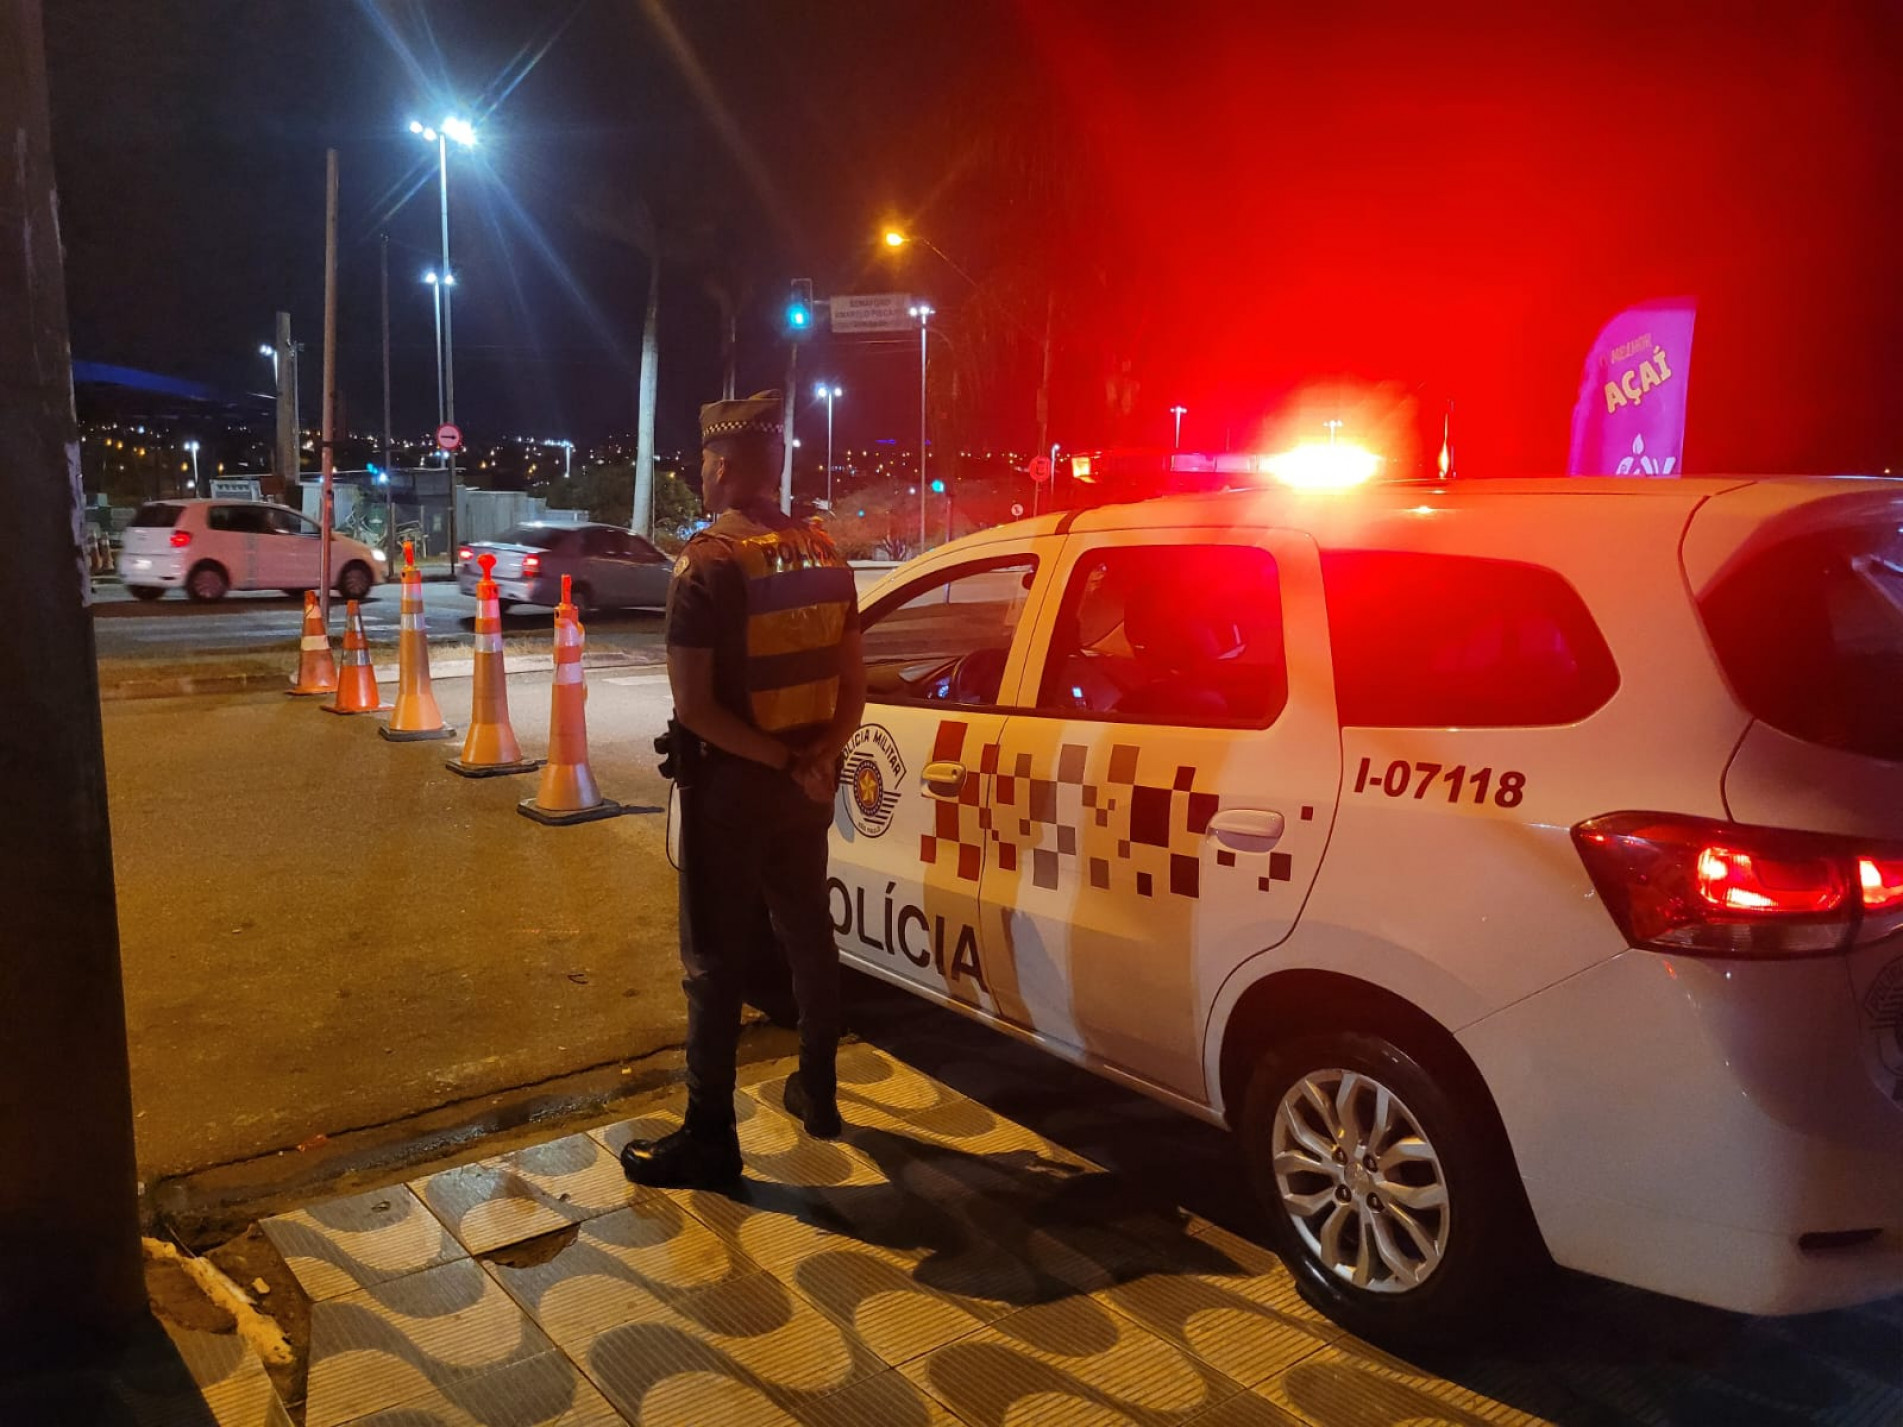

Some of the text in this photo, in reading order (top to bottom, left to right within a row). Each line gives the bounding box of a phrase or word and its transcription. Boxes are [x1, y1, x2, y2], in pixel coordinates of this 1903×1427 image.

[1604, 345, 1672, 414] AÇAÍ
[842, 729, 901, 777] OLICIA MILITAR
[1353, 757, 1526, 809] I-07118
[827, 877, 990, 994] OLÍCIA
